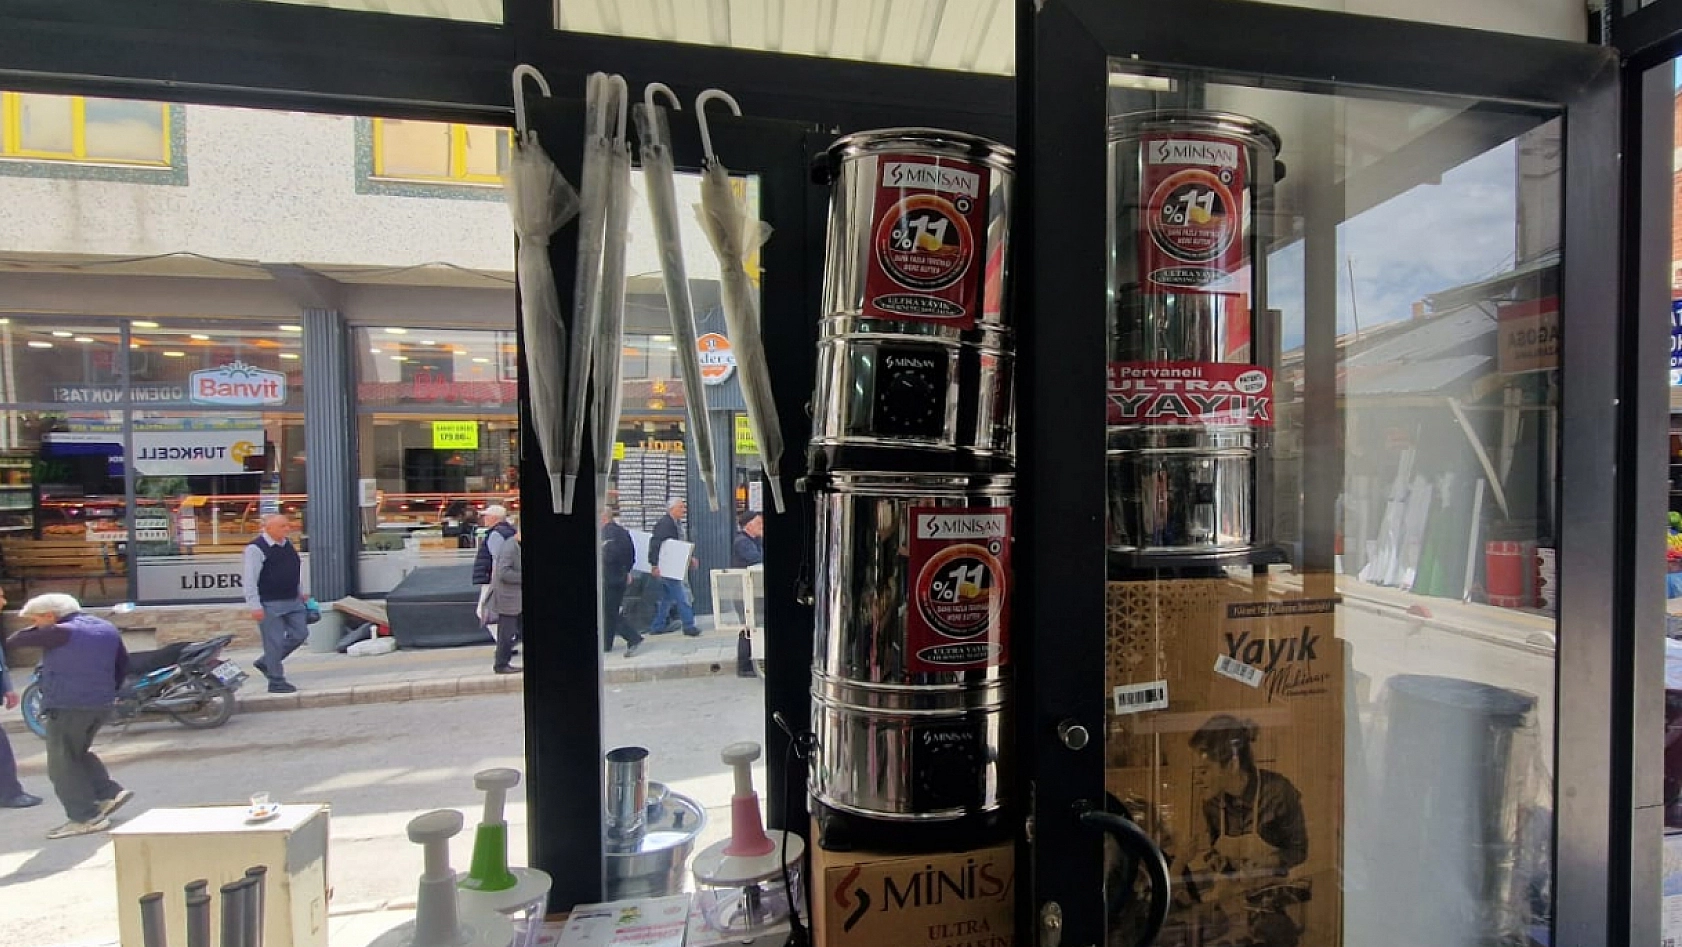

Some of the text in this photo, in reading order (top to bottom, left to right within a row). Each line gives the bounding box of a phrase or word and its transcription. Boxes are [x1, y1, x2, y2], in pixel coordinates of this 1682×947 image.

[1121, 366, 1203, 379] Pervaneli
[199, 377, 280, 398] Banvit
[1107, 379, 1235, 392] ULTRA
[1108, 392, 1270, 421] YAYIK
[181, 570, 243, 590] LİDER
[930, 918, 990, 941] ULTRA
